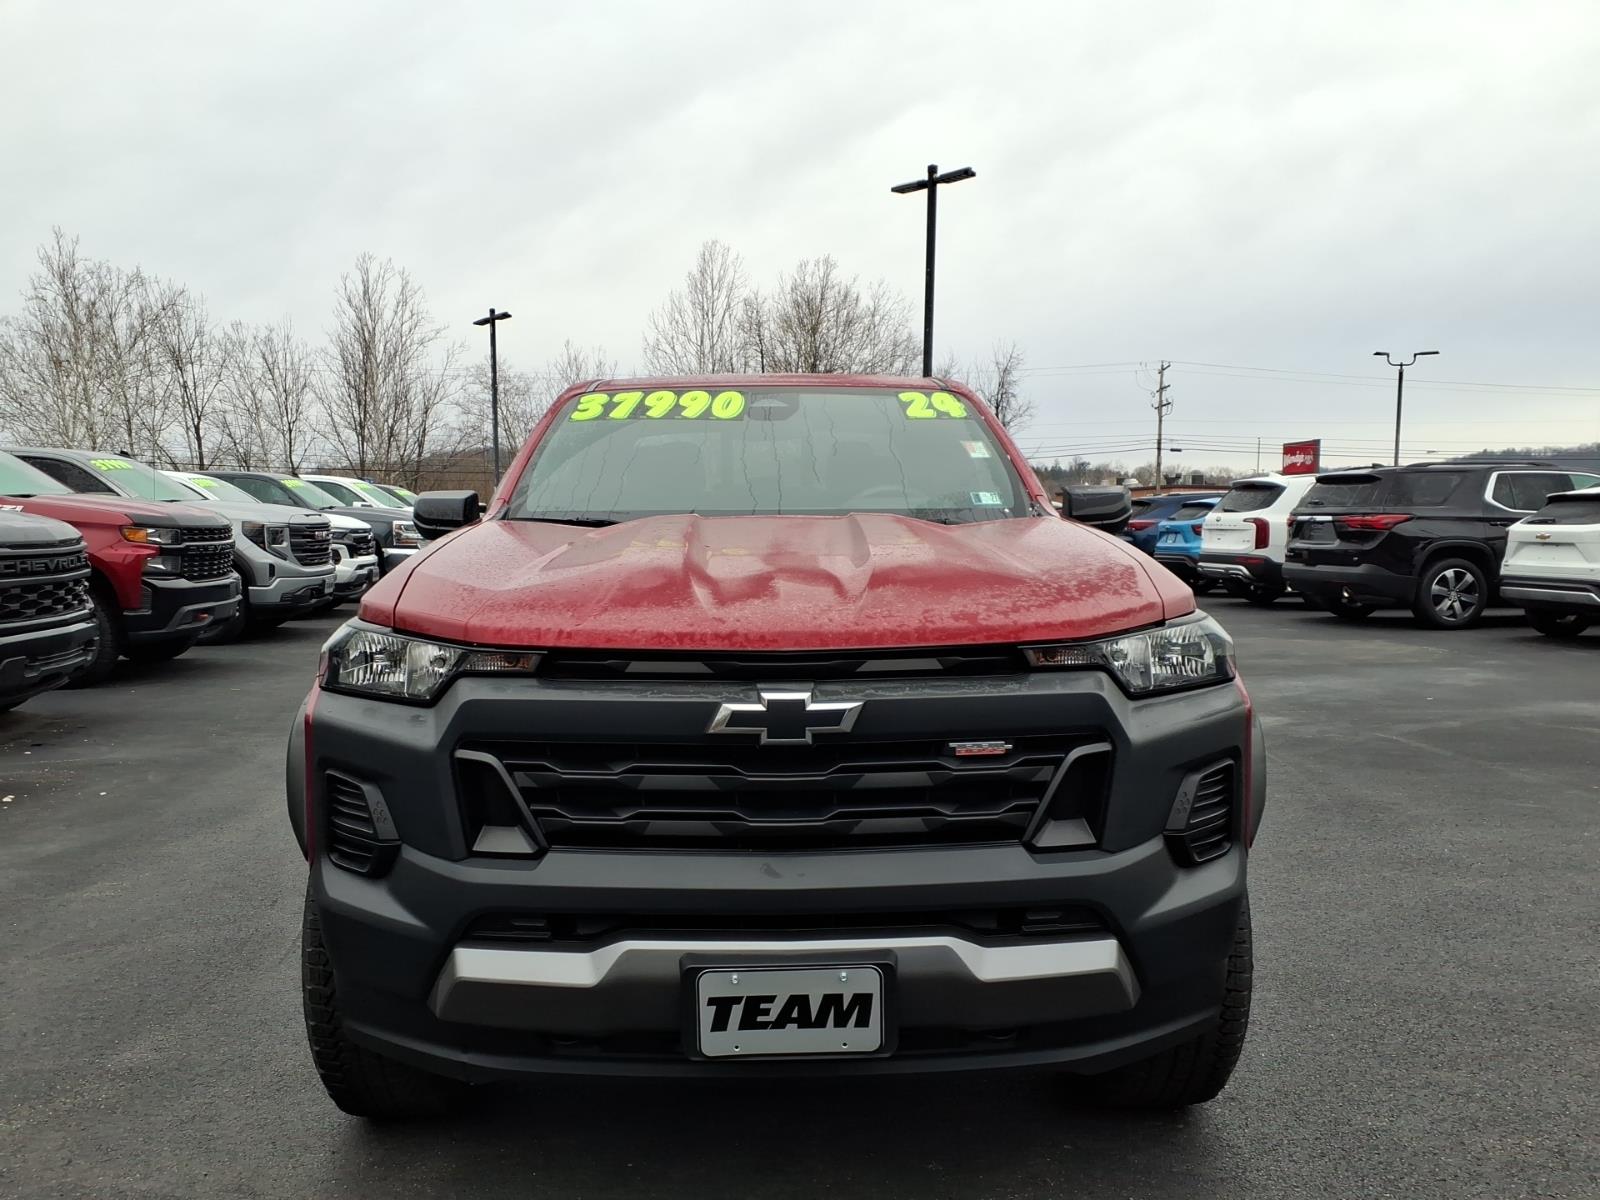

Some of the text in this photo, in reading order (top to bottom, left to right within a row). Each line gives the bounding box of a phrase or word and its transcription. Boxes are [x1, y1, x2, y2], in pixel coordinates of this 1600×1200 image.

[570, 391, 746, 421] 37990
[898, 391, 967, 418] 24
[706, 992, 874, 1033] TEAM
